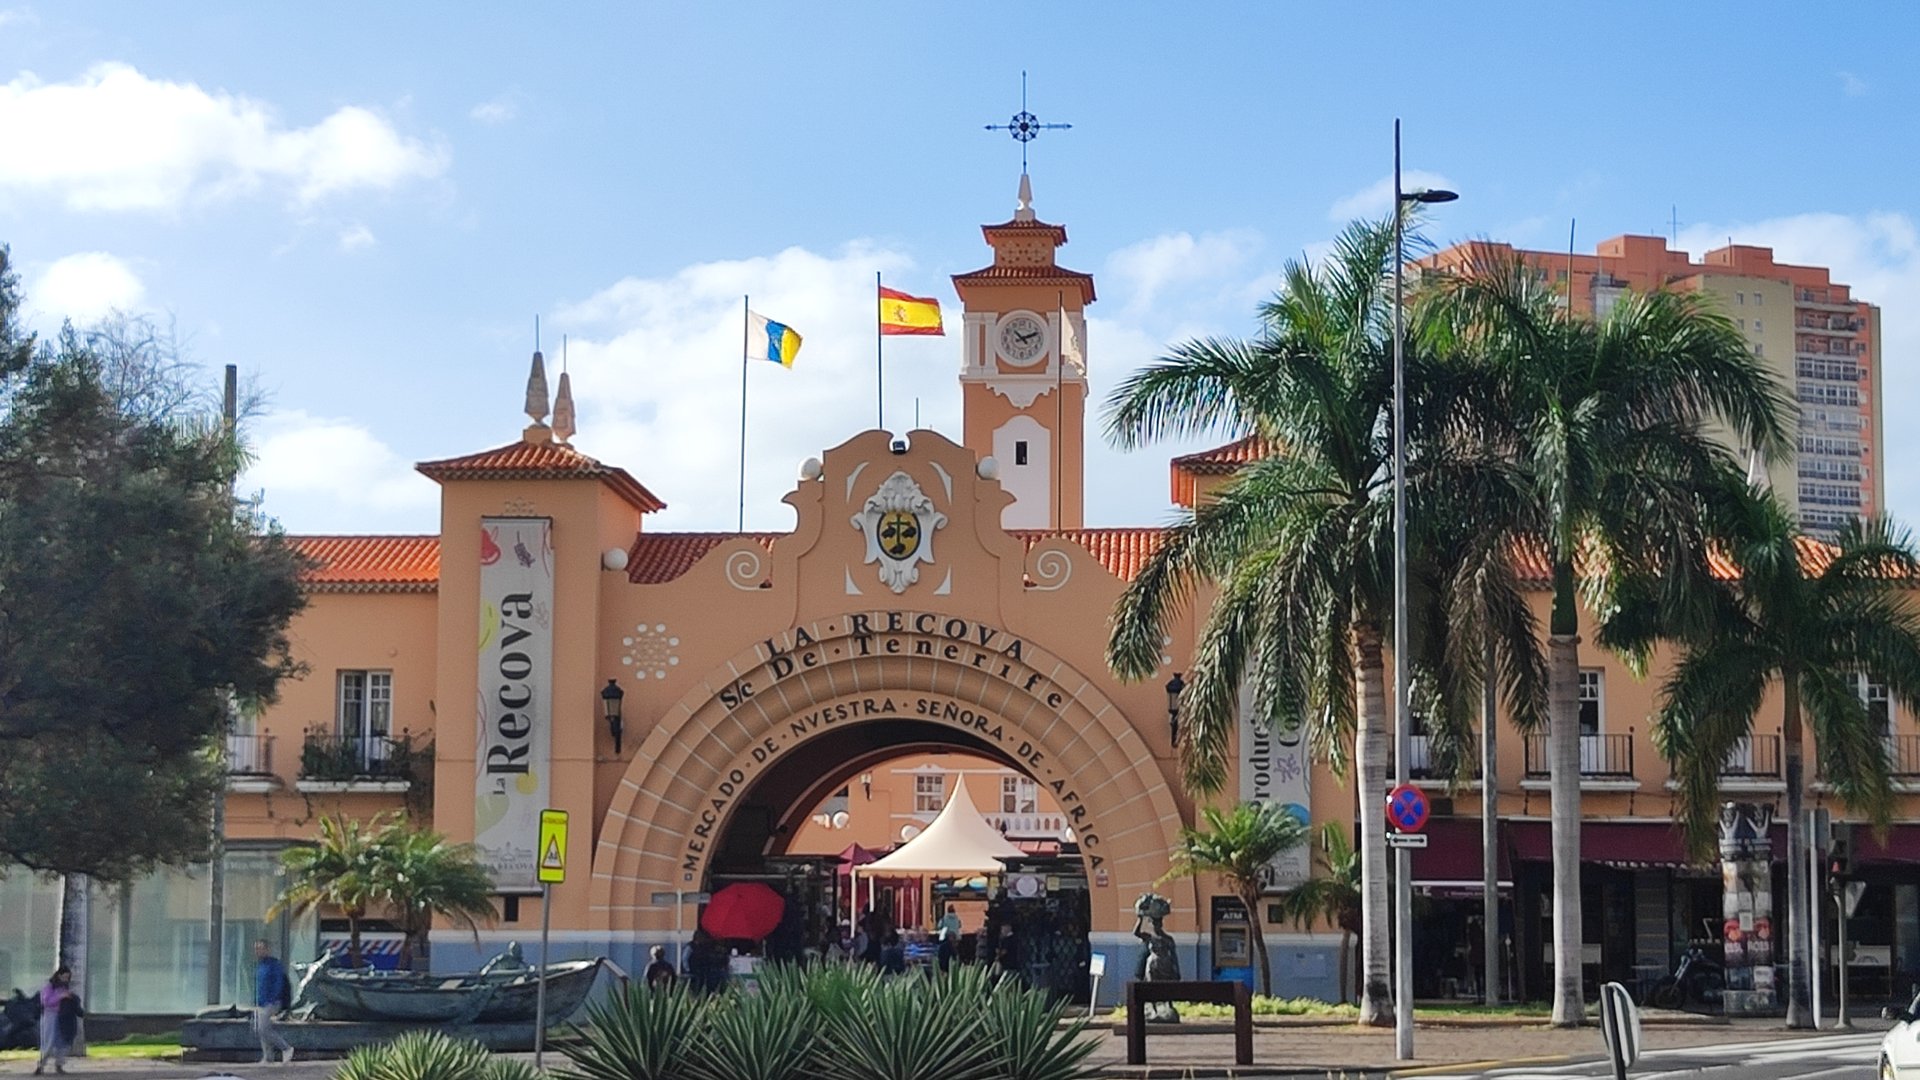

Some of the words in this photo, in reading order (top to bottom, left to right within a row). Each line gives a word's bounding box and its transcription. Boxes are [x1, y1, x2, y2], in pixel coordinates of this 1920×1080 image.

[763, 626, 816, 660] LA
[851, 611, 1024, 662] RECOVA
[770, 651, 818, 680] De
[854, 634, 1063, 709] Tenerife
[486, 590, 534, 777] Recova
[682, 768, 745, 871] MERCADO
[751, 737, 780, 764] DE
[789, 698, 897, 738] NVESTRA
[916, 698, 1004, 742] SEÑORA
[1017, 741, 1044, 769] DE
[1049, 779, 1105, 870] AFRICA
[1222, 911, 1243, 920] ATM
